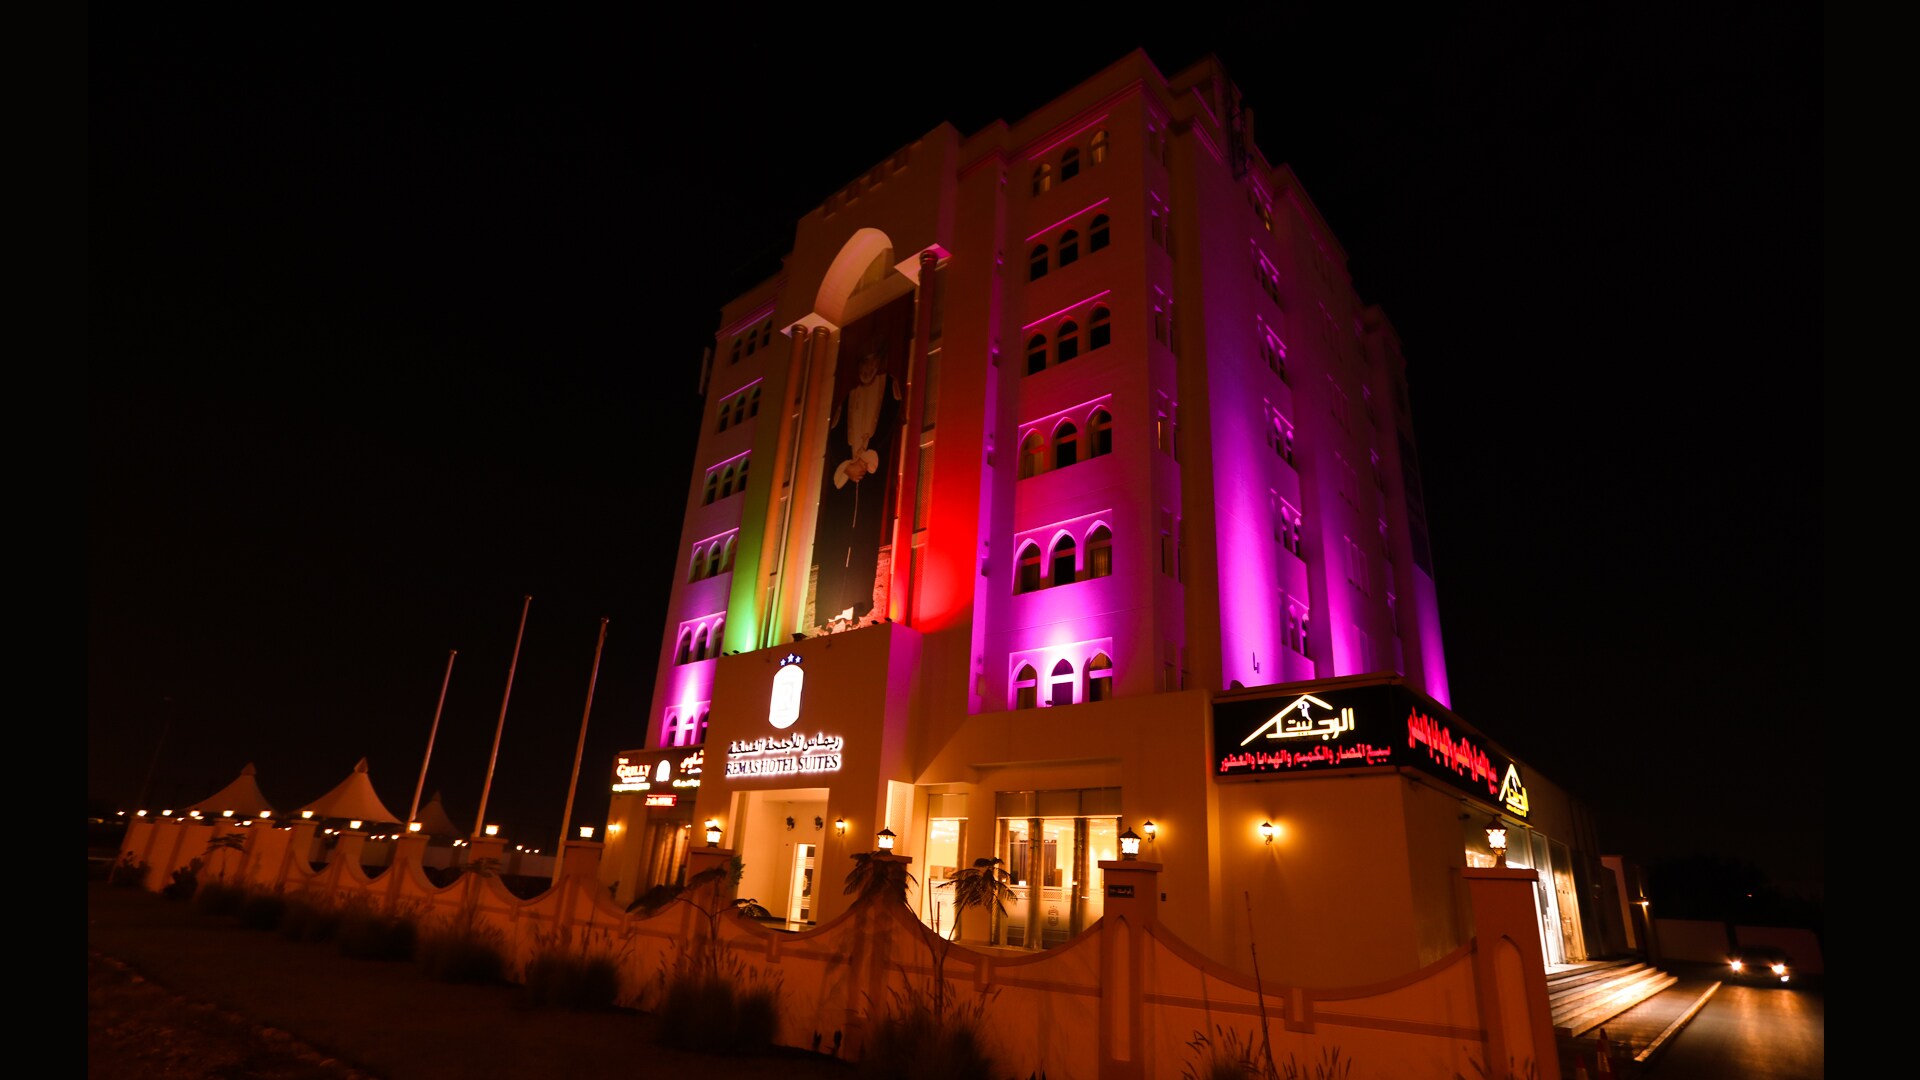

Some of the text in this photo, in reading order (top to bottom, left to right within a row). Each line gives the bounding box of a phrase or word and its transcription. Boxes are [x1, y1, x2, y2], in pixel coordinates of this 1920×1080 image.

[802, 732, 842, 752] ريماس
[1220, 752, 1255, 772] والعطور
[1256, 750, 1292, 770] والهدايا
[1366, 744, 1391, 764] بيع
[616, 764, 651, 778] GRILLY
[725, 754, 841, 776] REMAS HOTEL SUITES
